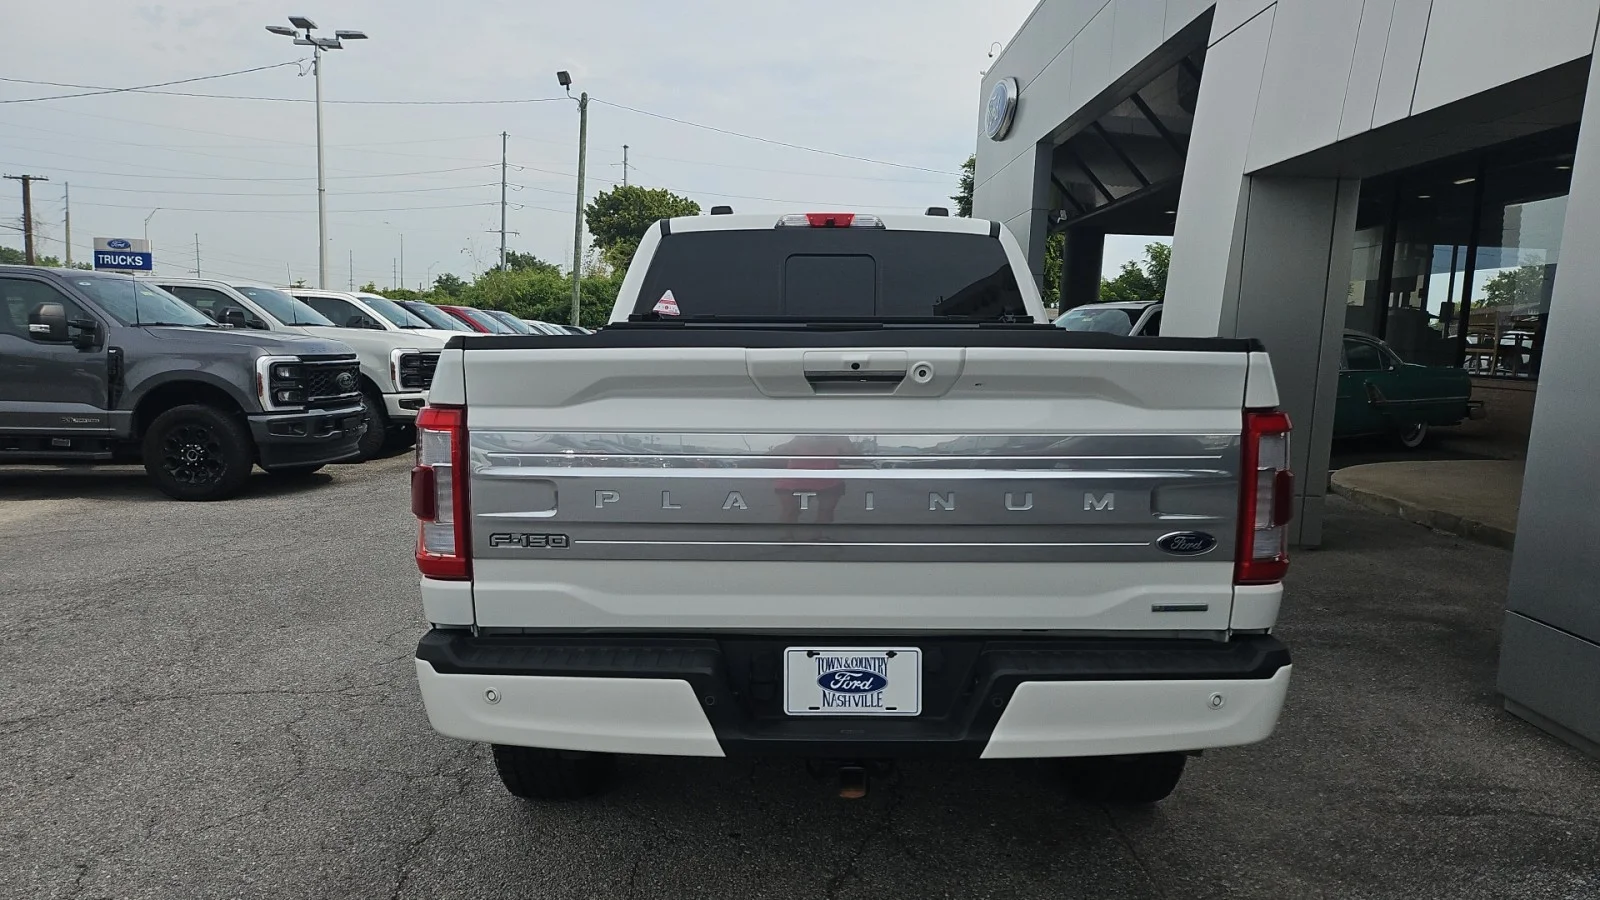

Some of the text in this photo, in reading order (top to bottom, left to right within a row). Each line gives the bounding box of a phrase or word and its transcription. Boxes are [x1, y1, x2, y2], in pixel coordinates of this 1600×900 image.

[97, 254, 143, 266] TRUCKS
[594, 489, 1115, 511] PLATINUM
[489, 533, 569, 549] F-150
[1170, 536, 1203, 550] Ford
[815, 656, 842, 675] TOWN
[850, 656, 889, 676] COUNTRY
[830, 671, 874, 690] Ford
[822, 690, 883, 708] NASHVILLE
